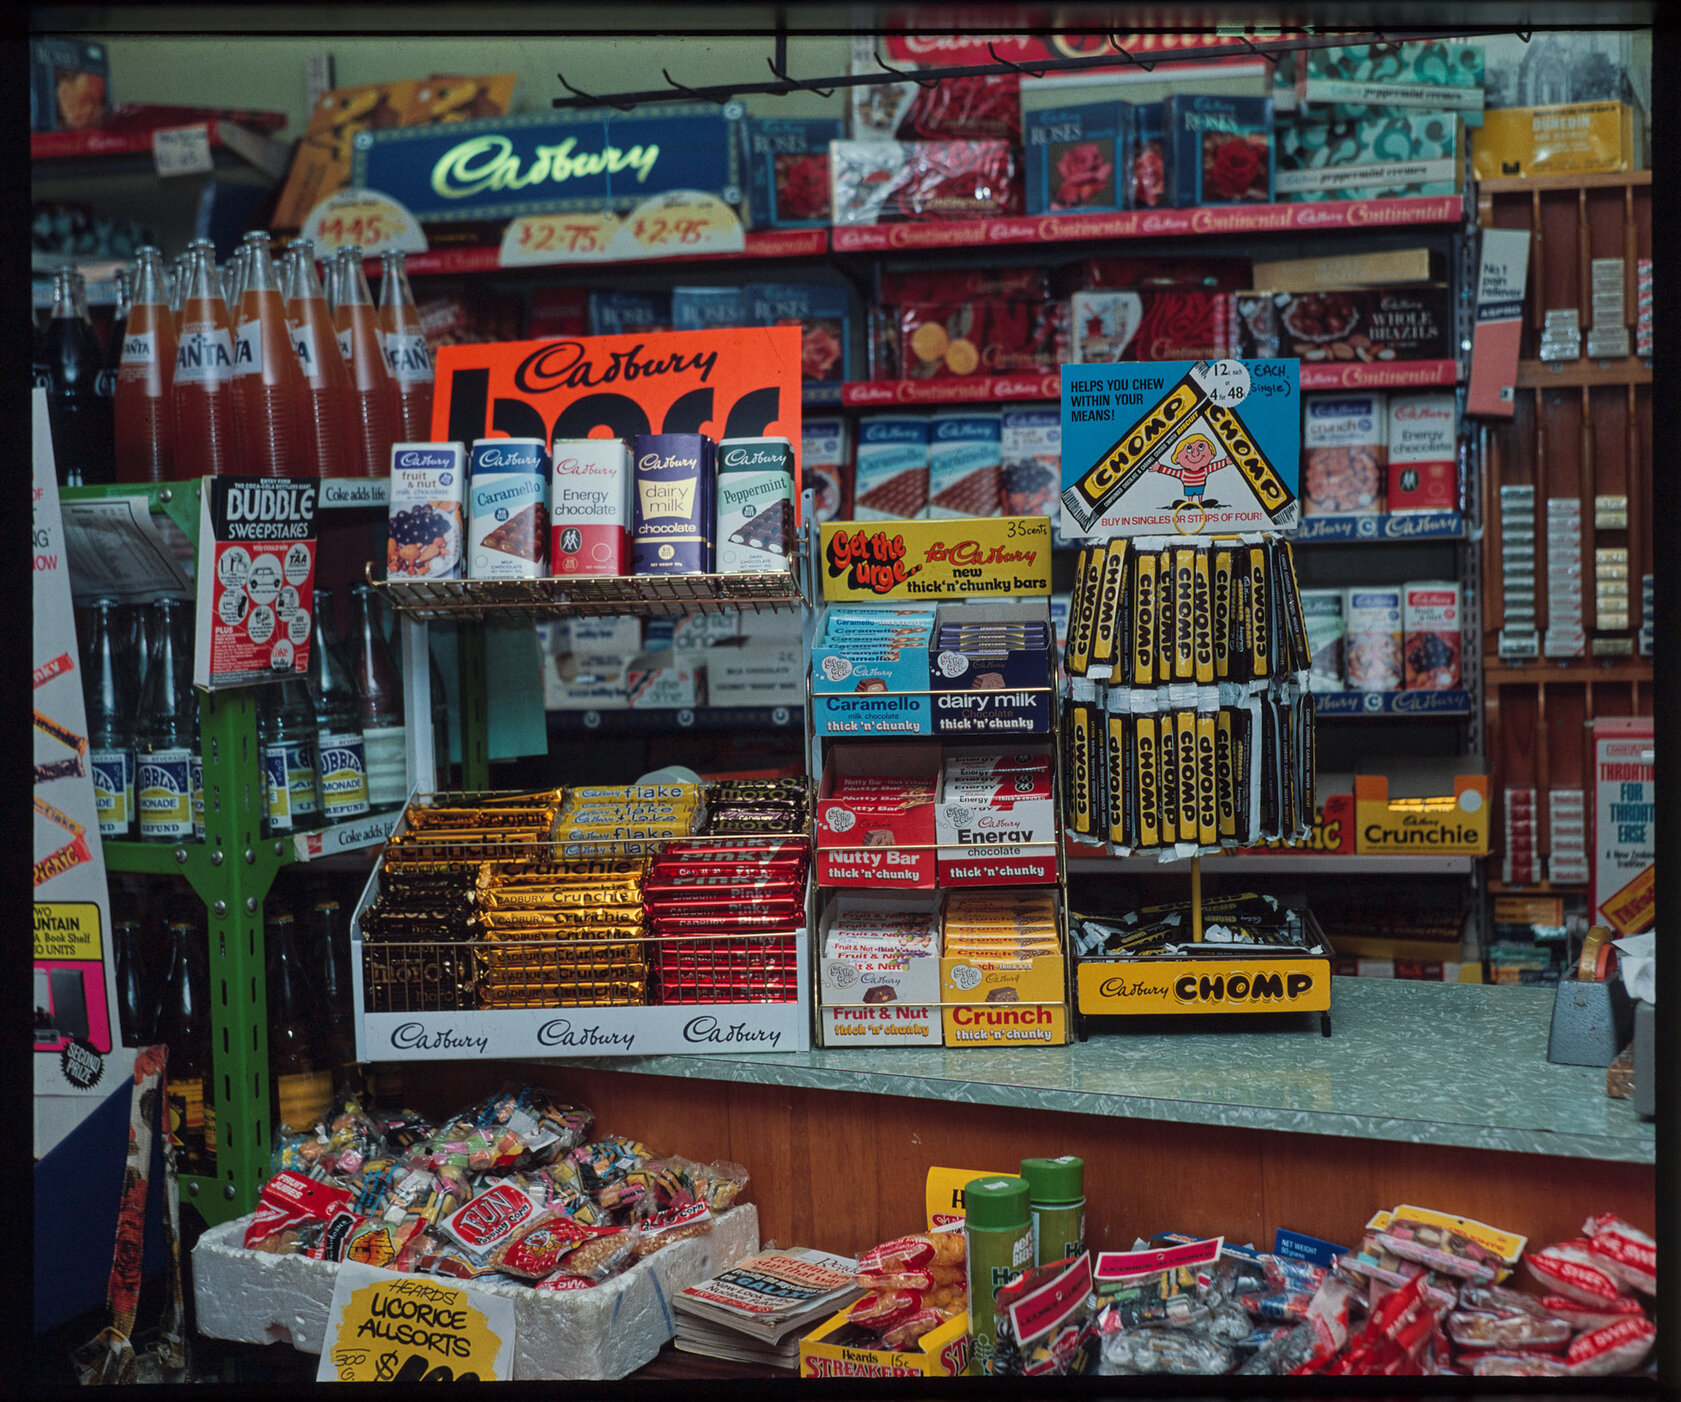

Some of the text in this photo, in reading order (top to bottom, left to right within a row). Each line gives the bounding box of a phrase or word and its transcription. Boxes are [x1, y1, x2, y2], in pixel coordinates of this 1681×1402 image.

[1532, 115, 1591, 132] DUNEDIN
[431, 134, 660, 199] Cadbury
[889, 223, 987, 248] Continental
[1038, 211, 1138, 241] Continental
[1191, 202, 1294, 233] Continental
[1346, 201, 1450, 223] Continental
[514, 341, 718, 394] Cadbury
[1070, 378, 1165, 393] HELPS YOU CHEW
[1210, 387, 1218, 400] 4
[1071, 393, 1144, 408] WITHIN YOUR
[1071, 408, 1115, 423] MEANS!
[1394, 404, 1452, 421] Cadbury
[1175, 410, 1199, 435] BISCUIT
[1095, 397, 1187, 489] CHOMP
[1209, 403, 1282, 498] CHOMP
[400, 452, 450, 468] Cadbury
[479, 449, 542, 468] Cadbury
[638, 453, 698, 472] Cadbury
[724, 449, 787, 467] Cadbury
[402, 471, 427, 481] fruit
[556, 458, 618, 478] Cadbury
[413, 488, 449, 496] chocolate
[416, 480, 437, 489] nut
[723, 476, 788, 504] Peppermint
[325, 486, 386, 501] Coke adds life
[477, 482, 541, 507] Caramello
[563, 489, 609, 504] Energy
[645, 485, 689, 501] dairy
[226, 488, 316, 521] BUBBLE
[554, 502, 616, 516] chocolate
[649, 499, 685, 512] milk
[1101, 512, 1262, 527] BUY IN SINGLES OR STRIPS OF FOUR!
[1385, 516, 1459, 537] Cadbury
[228, 522, 309, 540] SWEEPSTAKES
[638, 523, 697, 535] chocolate
[832, 529, 907, 569] Get the
[924, 540, 1038, 567] for Cadbury
[289, 553, 308, 565] TAA
[952, 566, 983, 578] new
[1013, 576, 1047, 589] bars
[1100, 552, 1122, 642] CHOMP
[1215, 568, 1229, 660] CHOMP
[1252, 565, 1267, 658] CHOMP
[1137, 573, 1153, 667] CHOMP
[215, 626, 234, 634] PLUS
[852, 664, 893, 678] Cadbury
[826, 696, 921, 711] Caramello
[938, 692, 1037, 711] dairy milk
[1392, 693, 1465, 713] Cadbury
[848, 712, 899, 720] milk chocolate
[961, 708, 1014, 718] Chocolate
[827, 719, 921, 733] thick chunky
[940, 716, 1034, 730] thick chunky
[1180, 729, 1196, 822] CHOMP
[1200, 735, 1215, 828] CHOMP
[581, 785, 684, 799] Cadbury flake
[720, 788, 787, 801] moro
[1620, 783, 1643, 801] FOR
[325, 803, 365, 815] REFUND
[1609, 803, 1655, 823] THROAT
[977, 816, 1021, 829] Cadbury
[1402, 815, 1439, 827] Cadbury
[338, 825, 383, 846] Coke adds
[568, 828, 674, 841] Cadbury flake
[957, 829, 1034, 844] Energy
[1364, 824, 1480, 844] Crunchie
[1617, 824, 1647, 844] EASE
[680, 850, 779, 865] Pinky
[828, 850, 920, 867] Nutty Bar
[967, 846, 1021, 857] chocolate
[502, 859, 633, 877] Crunchie
[828, 867, 920, 882] thick chunky
[950, 864, 1045, 879] thick chunky
[497, 891, 629, 905] CADBURY Crunchie
[44, 933, 66, 943] Book
[46, 943, 76, 956] UNITS
[860, 973, 902, 986] Cadbury
[985, 973, 1021, 984] Cadbury
[1100, 971, 1315, 1002] Cadbury CHOMP
[833, 1006, 929, 1020] Fruit & Nut
[952, 1005, 1053, 1026] Crunch
[390, 1021, 489, 1054] Cadbury
[537, 1018, 636, 1051] Cadbury
[682, 1015, 781, 1048] Cadbury
[834, 1023, 930, 1037] thick chunky
[956, 1028, 1052, 1042] thick chunky
[68, 1042, 101, 1072] SECOND
[66, 1060, 93, 1084] PRIZE
[270, 1180, 304, 1200] JUBES
[276, 1173, 308, 1191] FRUIT
[459, 1190, 516, 1234] FUN
[475, 1204, 530, 1245] Popping Corn
[1281, 1239, 1318, 1255] NET WEIGHT
[389, 1279, 459, 1306] HEARDS
[711, 1281, 735, 1292] New
[356, 1318, 471, 1358] ALLSORTS
[335, 1353, 367, 1367] 300
[841, 1348, 879, 1364] Heards
